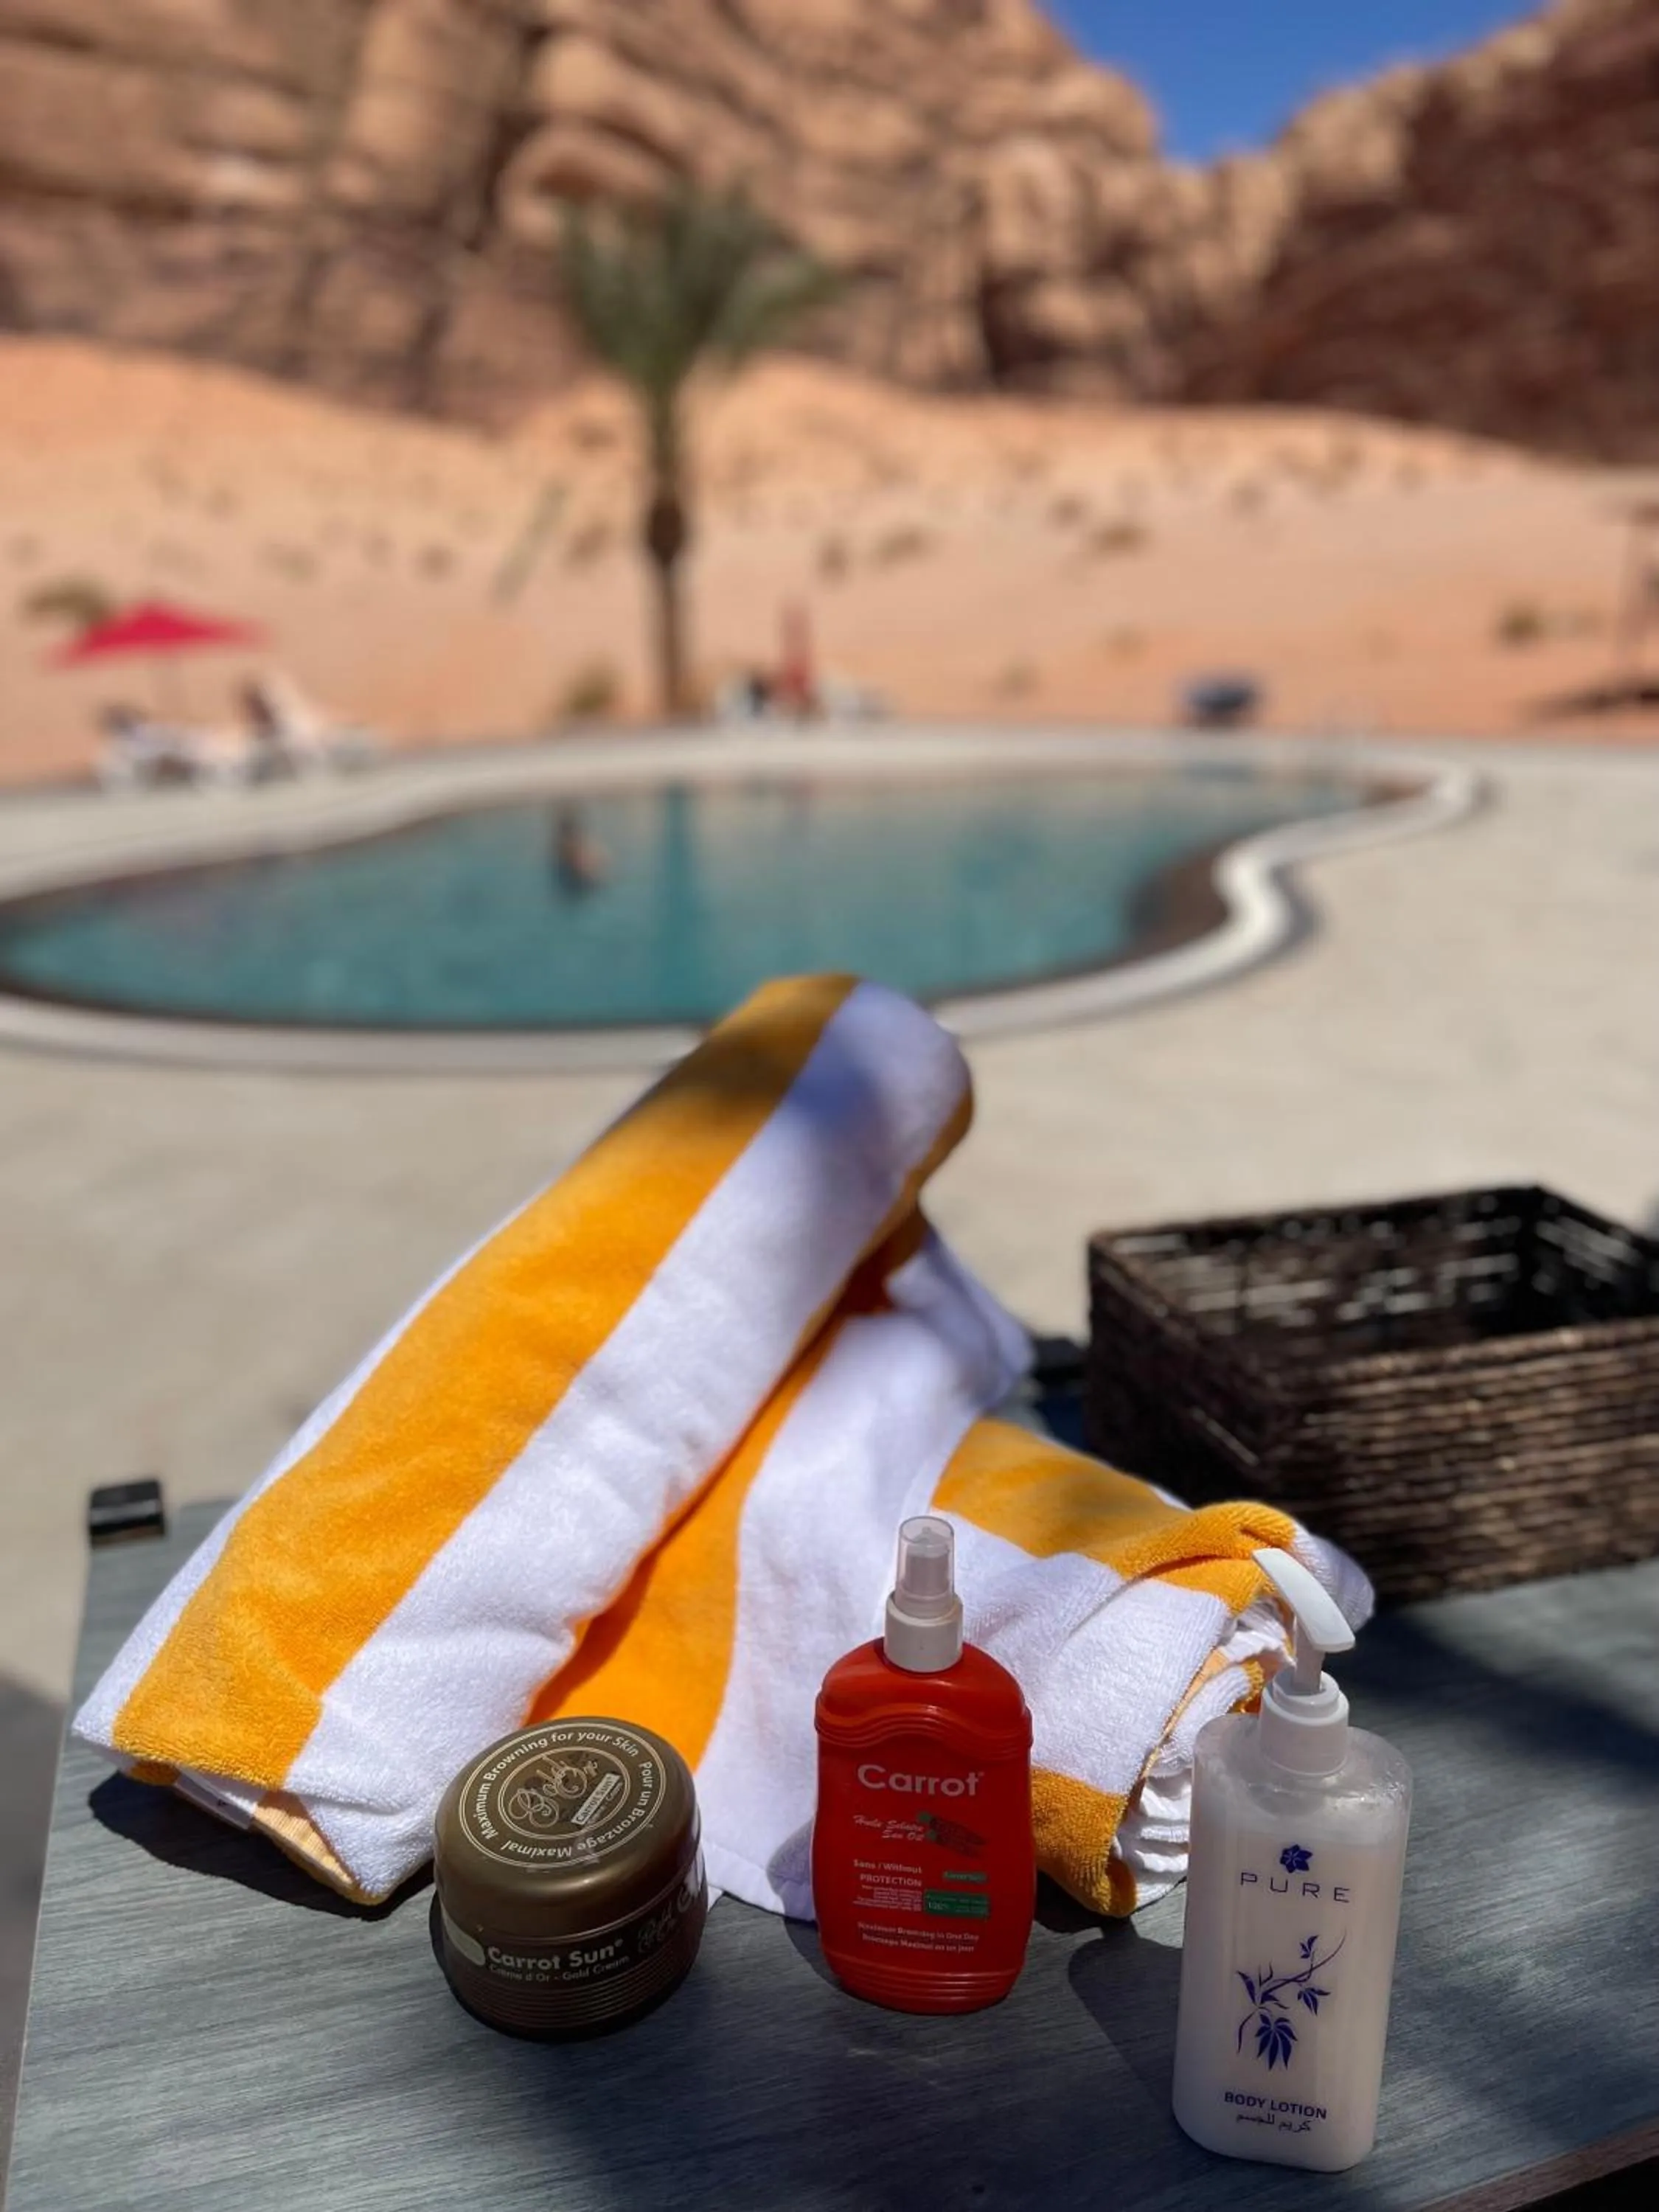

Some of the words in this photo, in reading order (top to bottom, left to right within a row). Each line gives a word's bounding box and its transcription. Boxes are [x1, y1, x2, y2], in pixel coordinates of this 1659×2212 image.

[552, 1731, 572, 1742] for
[577, 1732, 612, 1743] your
[613, 1736, 639, 1757] Skin
[484, 1738, 548, 1781] Browning
[639, 1761, 653, 1788] Pour
[857, 1764, 980, 1796] Carrot
[637, 1791, 652, 1806] un
[473, 1783, 498, 1839] Maximum
[577, 1807, 645, 1849] Bronzage
[501, 1840, 571, 1857] Maximal
[860, 1873, 922, 1887] PROTECTION
[883, 1863, 922, 1874] Without
[1239, 1871, 1351, 1903] PURE
[488, 1946, 560, 1970] Carrot
[1224, 2091, 1266, 2108] BODY
[1270, 2100, 1327, 2119] LOTION
